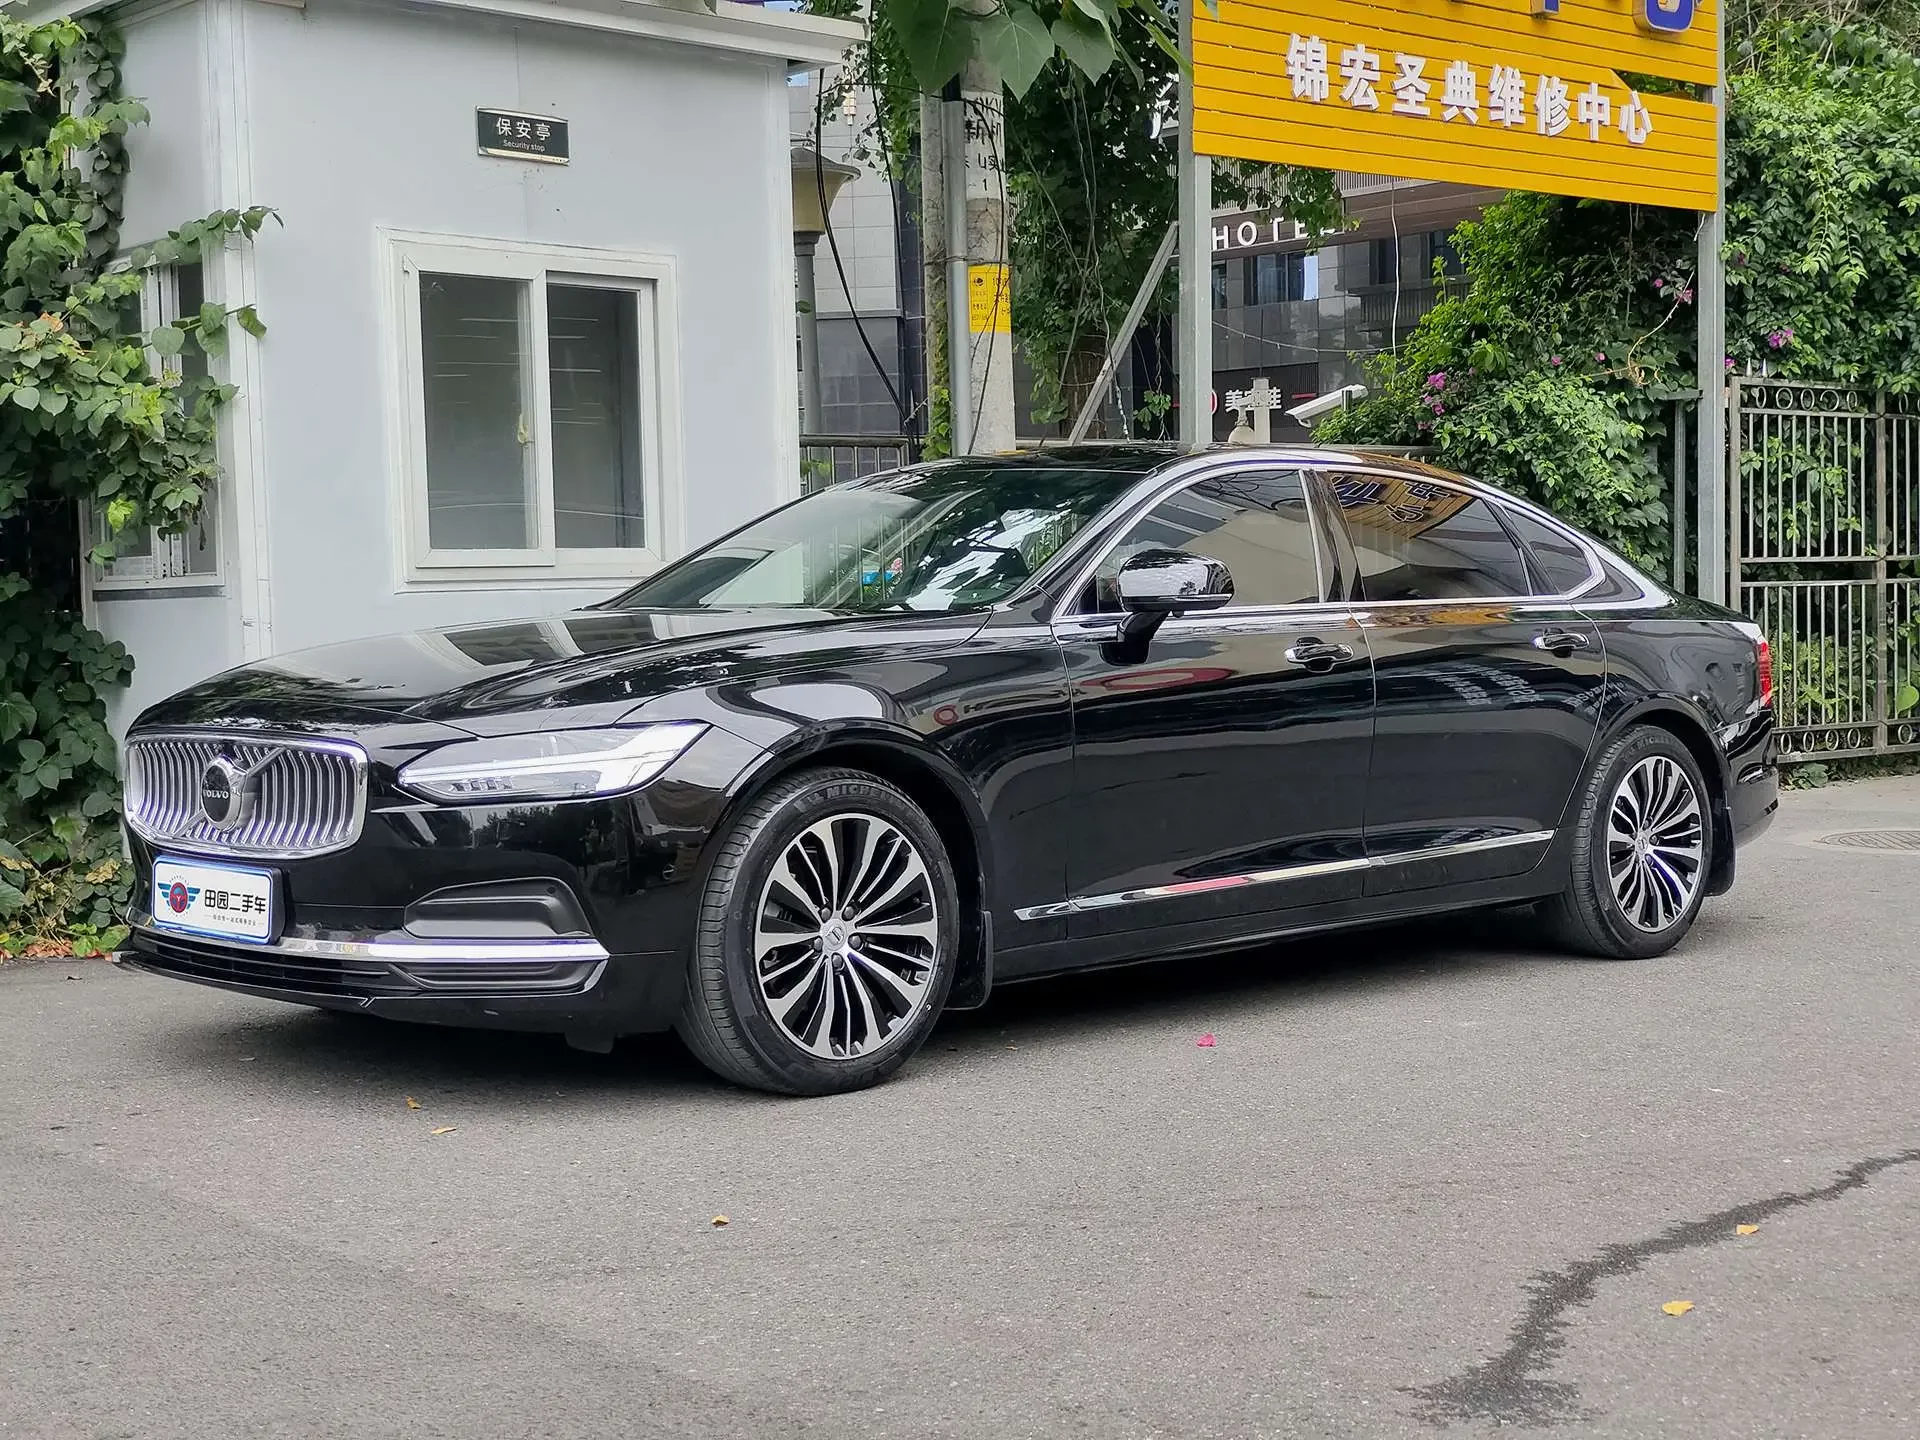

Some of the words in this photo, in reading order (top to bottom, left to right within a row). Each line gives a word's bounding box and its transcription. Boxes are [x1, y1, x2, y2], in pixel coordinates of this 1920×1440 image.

[1286, 33, 1653, 145] 锦宏圣典维修中心
[496, 117, 551, 141] 保安亭
[504, 140, 529, 150] Security
[530, 143, 545, 152] stop
[204, 889, 267, 914] 田园二手车
